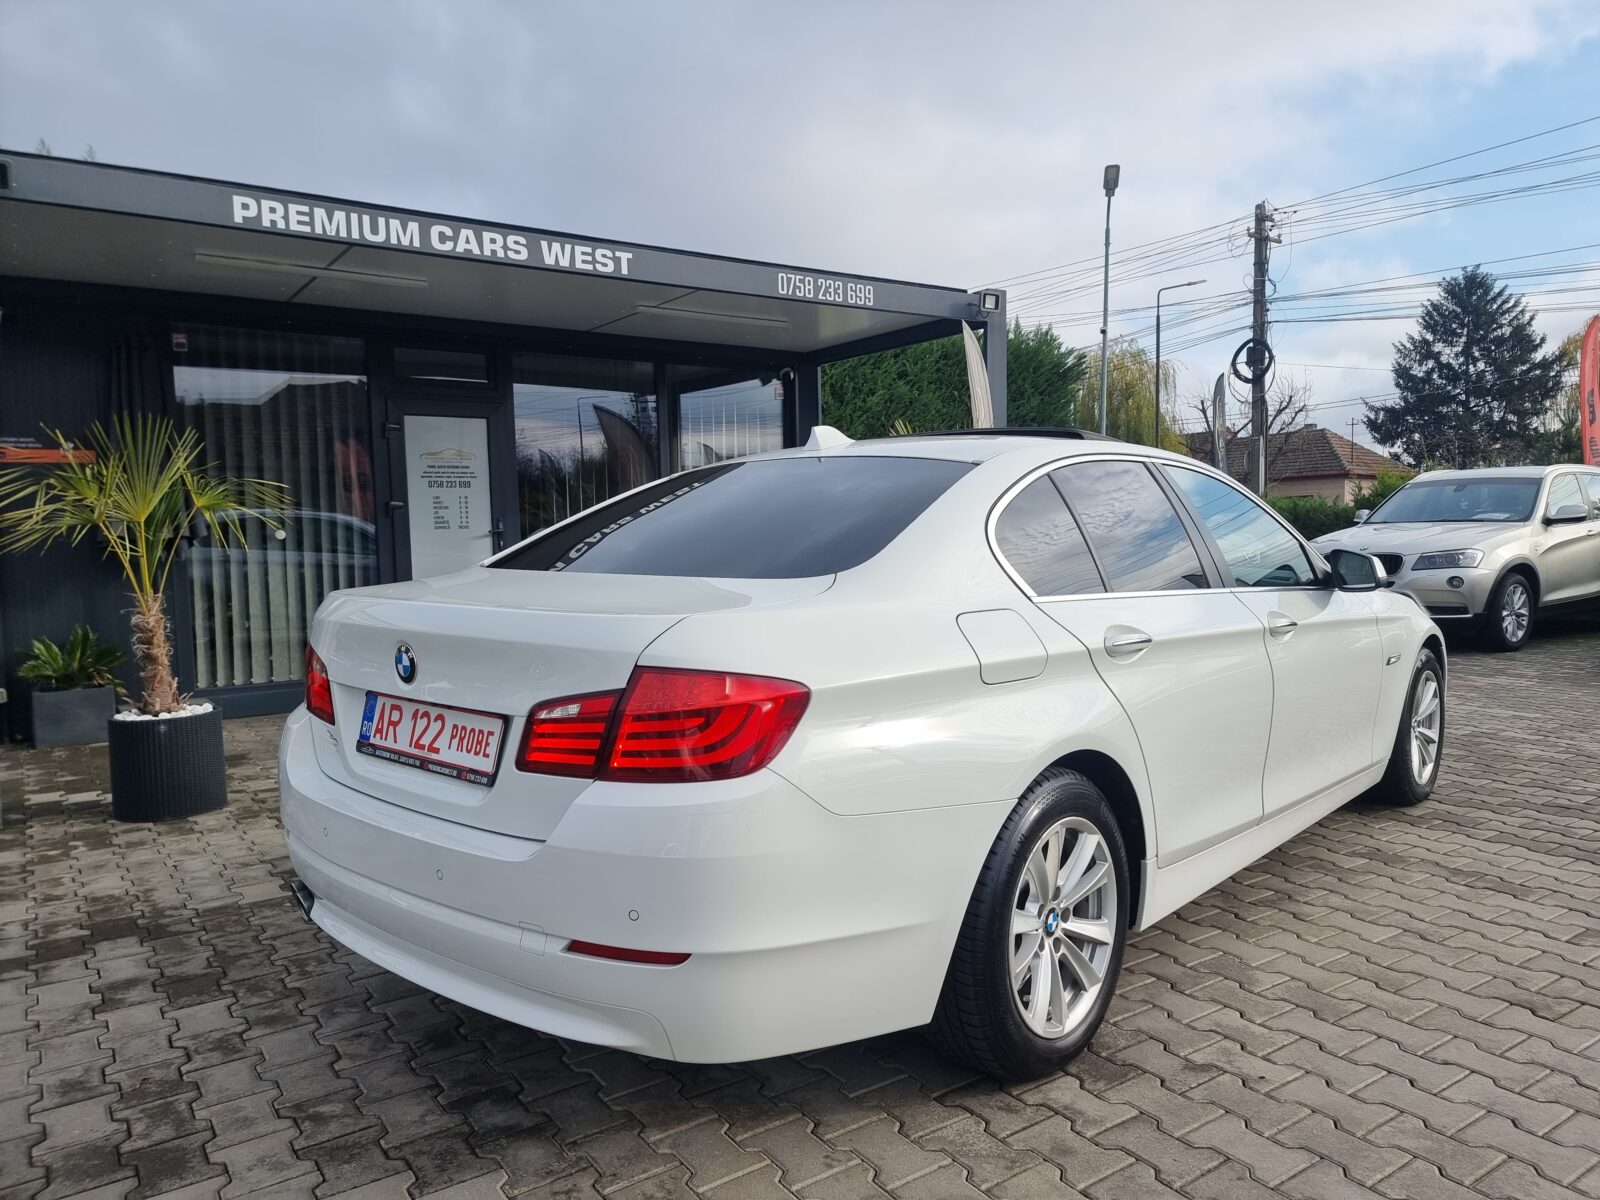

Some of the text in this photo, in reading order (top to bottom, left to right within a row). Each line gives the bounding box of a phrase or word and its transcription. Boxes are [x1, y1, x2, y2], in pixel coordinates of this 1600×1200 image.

[232, 194, 633, 275] PREMIUM CARS WEST
[778, 272, 874, 305] 0758 233 699
[428, 480, 471, 489] 0758 233 699
[361, 722, 373, 736] RO
[373, 702, 495, 758] AR 122 PROBE
